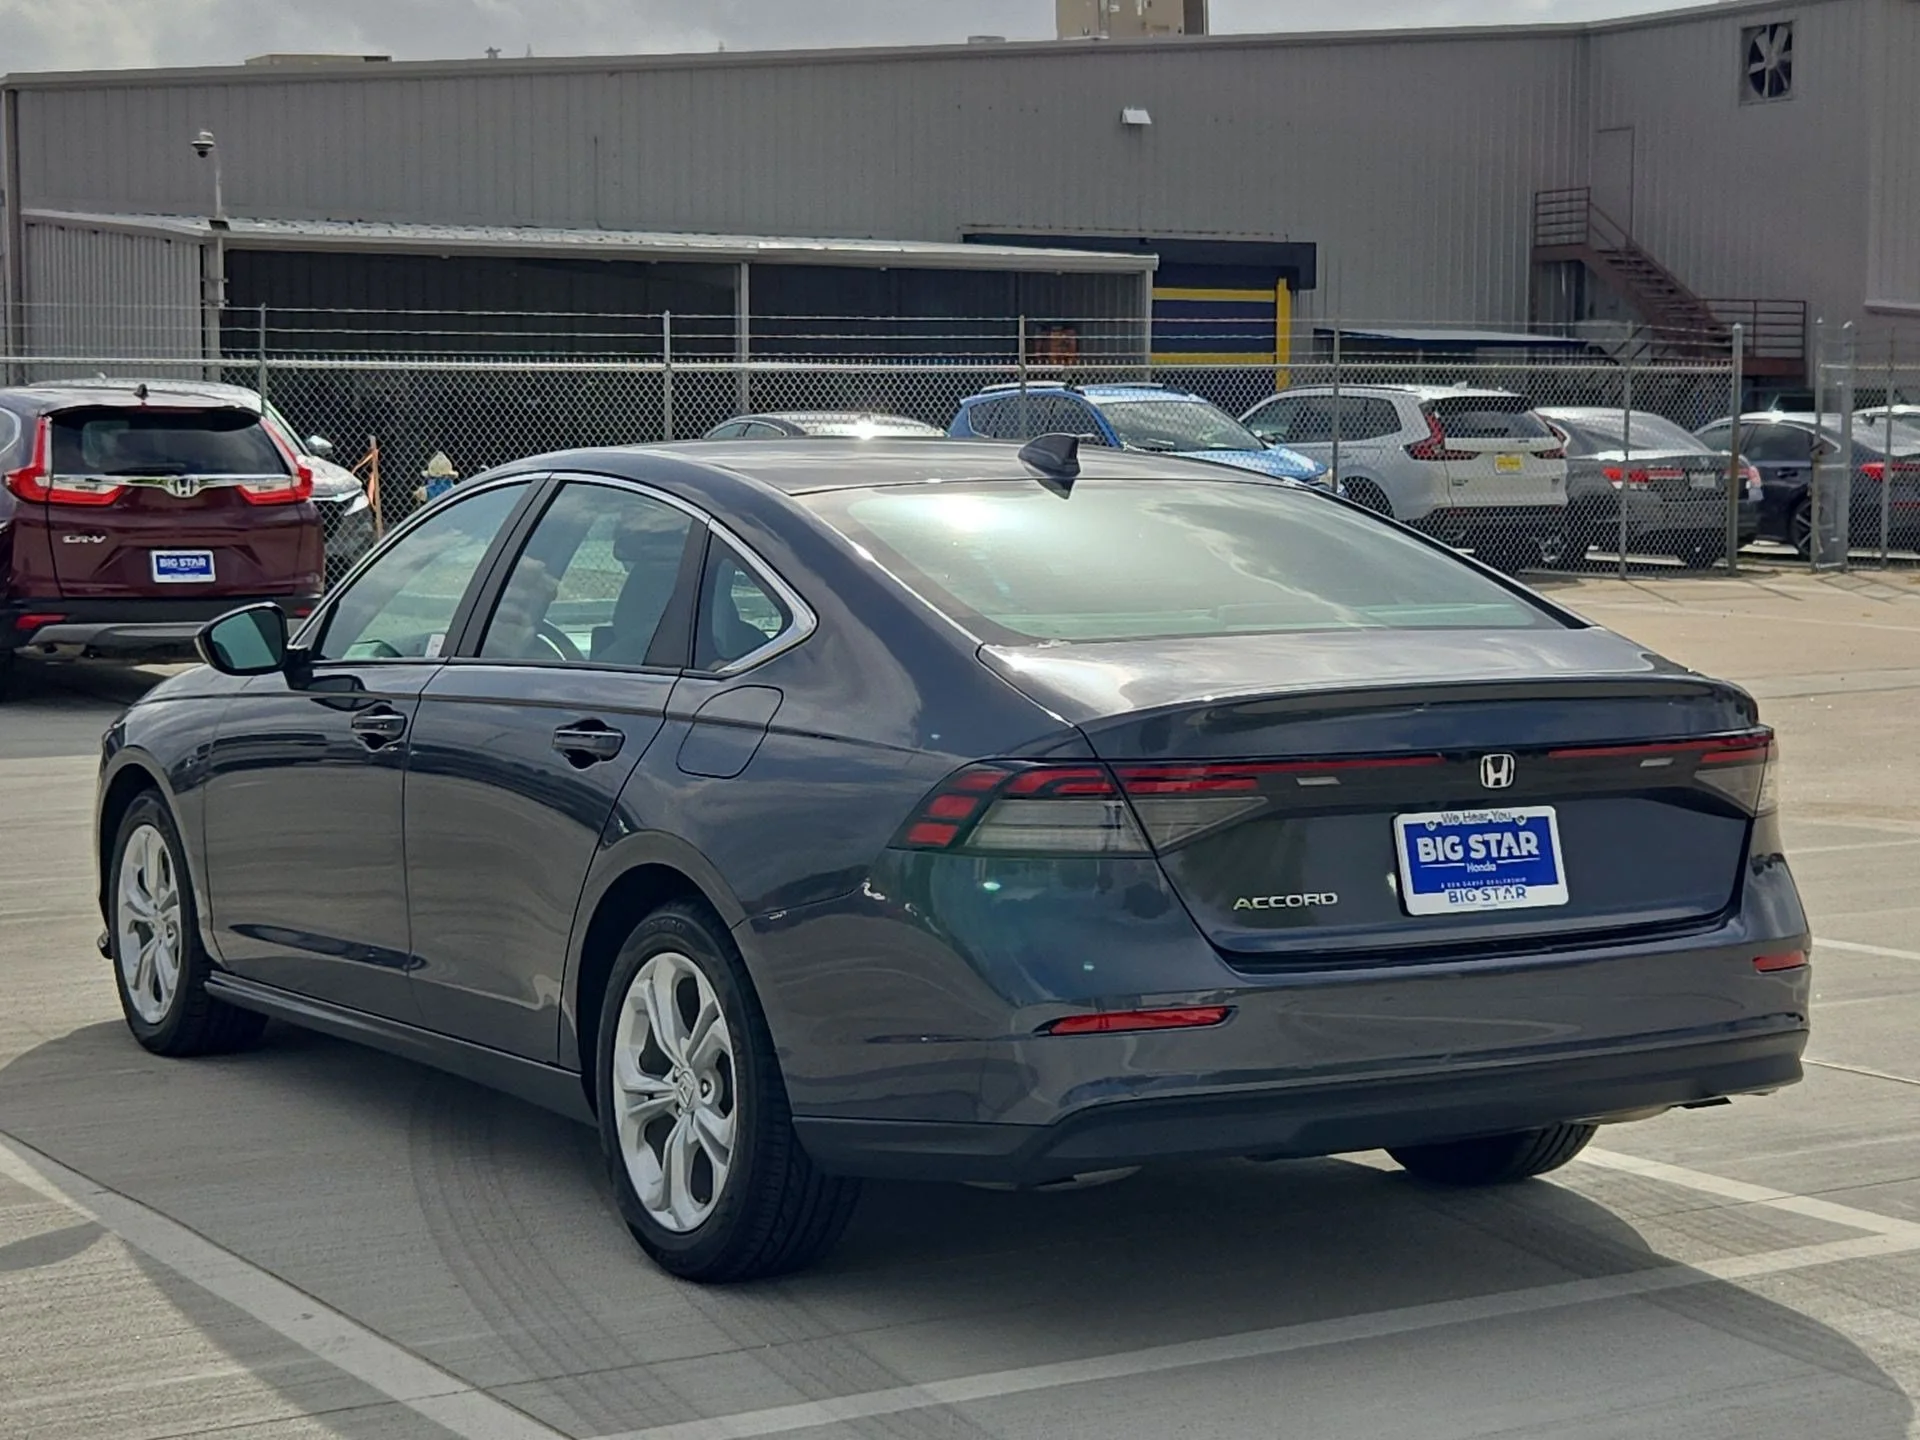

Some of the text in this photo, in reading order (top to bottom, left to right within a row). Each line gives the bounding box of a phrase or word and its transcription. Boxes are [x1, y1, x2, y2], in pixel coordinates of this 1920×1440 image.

[159, 557, 206, 568] BIG STAR
[1441, 809, 1512, 823] We Hear You
[1416, 831, 1540, 863] BIG STAR
[1466, 861, 1497, 873] Honda
[1233, 892, 1338, 910] ACCORD
[1448, 886, 1527, 903] BIG STAR
